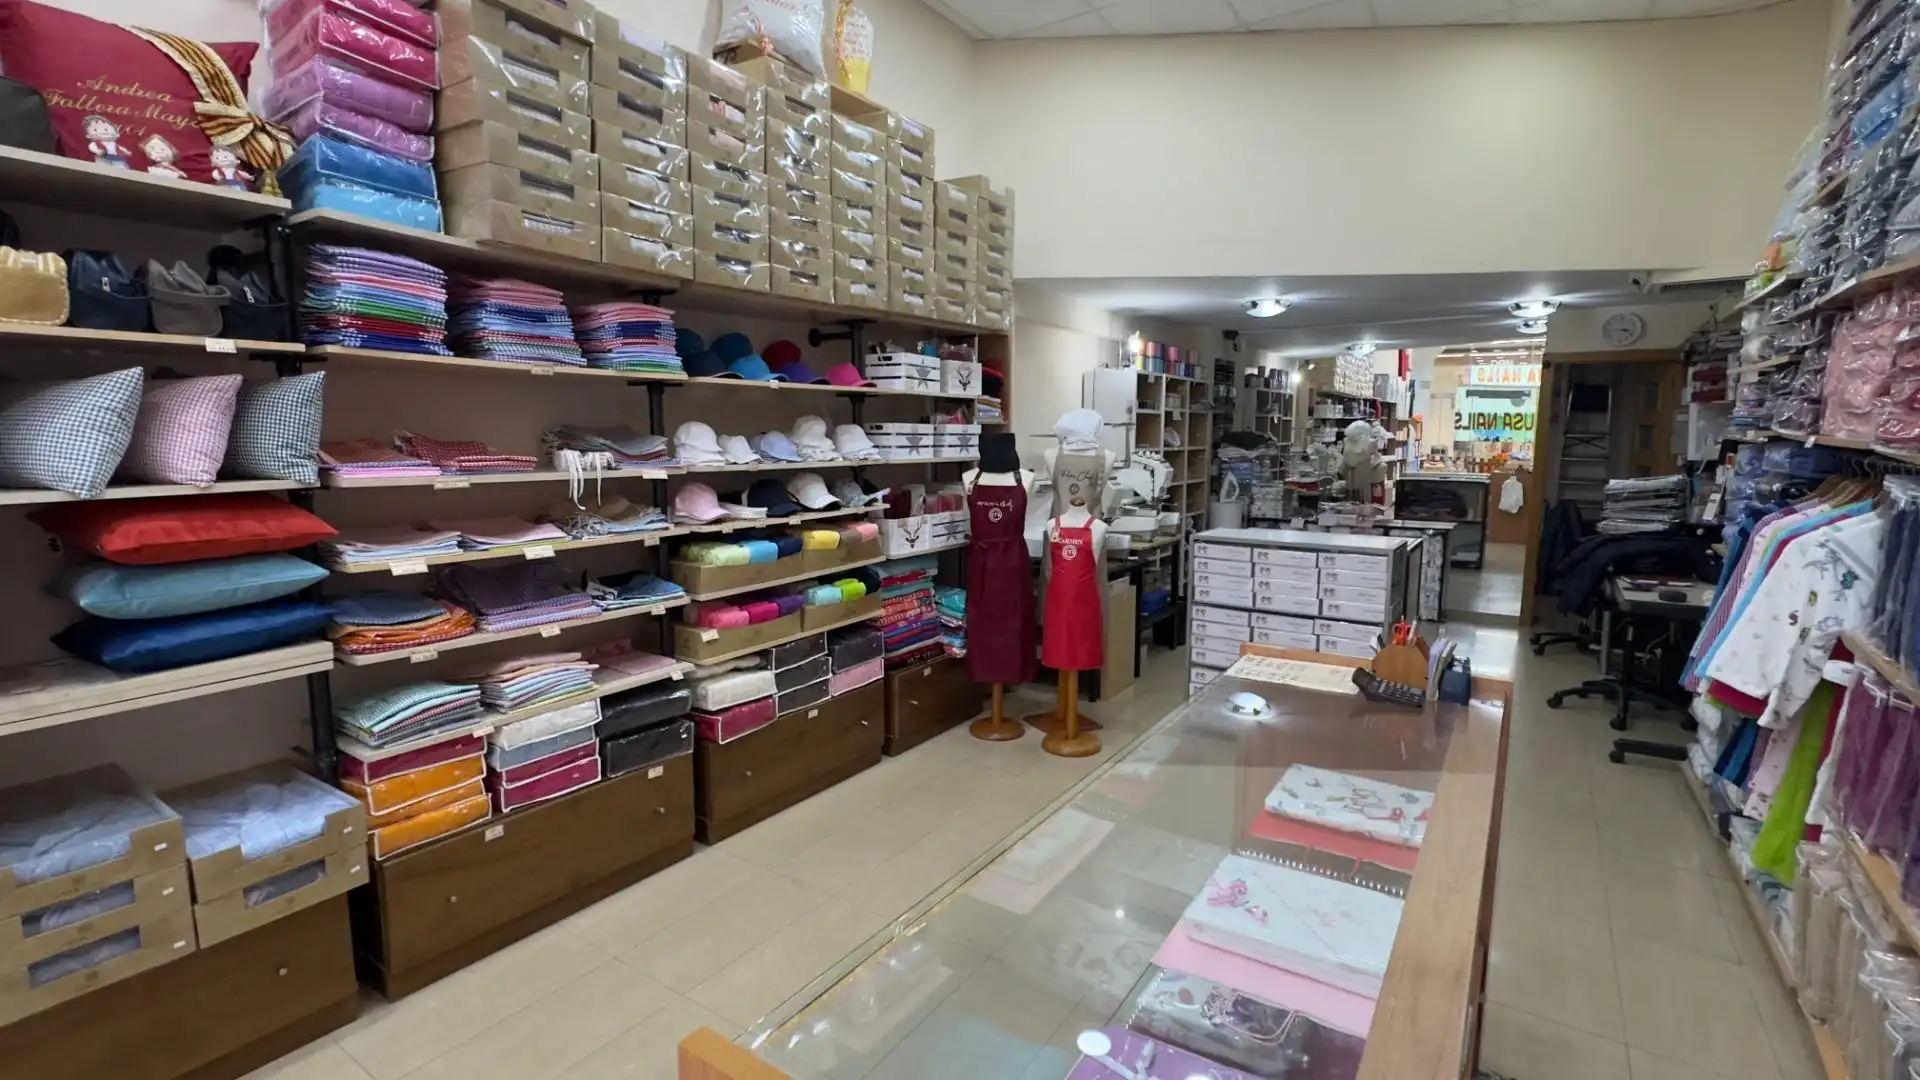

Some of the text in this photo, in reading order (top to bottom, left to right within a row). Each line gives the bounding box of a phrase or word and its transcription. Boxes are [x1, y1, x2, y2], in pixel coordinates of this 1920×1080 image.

[76, 75, 173, 102] Andrea
[42, 88, 133, 117] Fallera
[134, 103, 200, 131] Mayo
